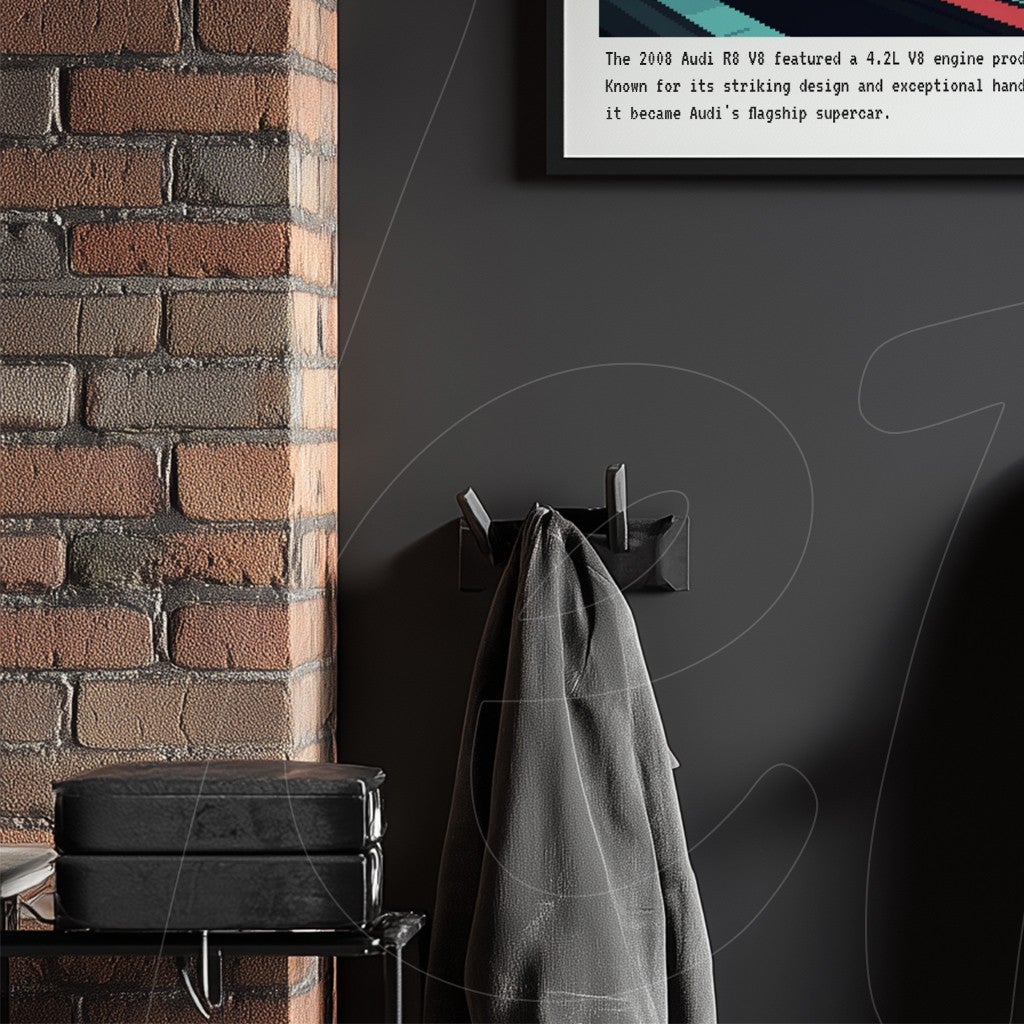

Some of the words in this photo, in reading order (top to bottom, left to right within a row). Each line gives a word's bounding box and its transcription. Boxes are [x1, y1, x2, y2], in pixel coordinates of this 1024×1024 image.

[605, 51, 631, 66] The
[639, 51, 673, 66] 2008
[681, 51, 714, 66] Audi
[723, 51, 740, 66] R8
[748, 51, 765, 66] V8
[774, 50, 841, 66] featured
[849, 54, 858, 66] a
[866, 50, 900, 66] 4.2L
[908, 50, 925, 66] V8
[933, 50, 984, 69] engine
[605, 78, 648, 93] Known
[656, 78, 682, 93] for
[690, 78, 714, 93] its
[723, 78, 791, 97] striking
[799, 78, 850, 97] design
[857, 78, 884, 93] and
[891, 78, 984, 97] exceptional
[605, 106, 622, 120] it
[630, 106, 682, 120] became
[689, 104, 740, 120] Audi's
[748, 105, 808, 124] flagship
[815, 108, 889, 124] supercar.
